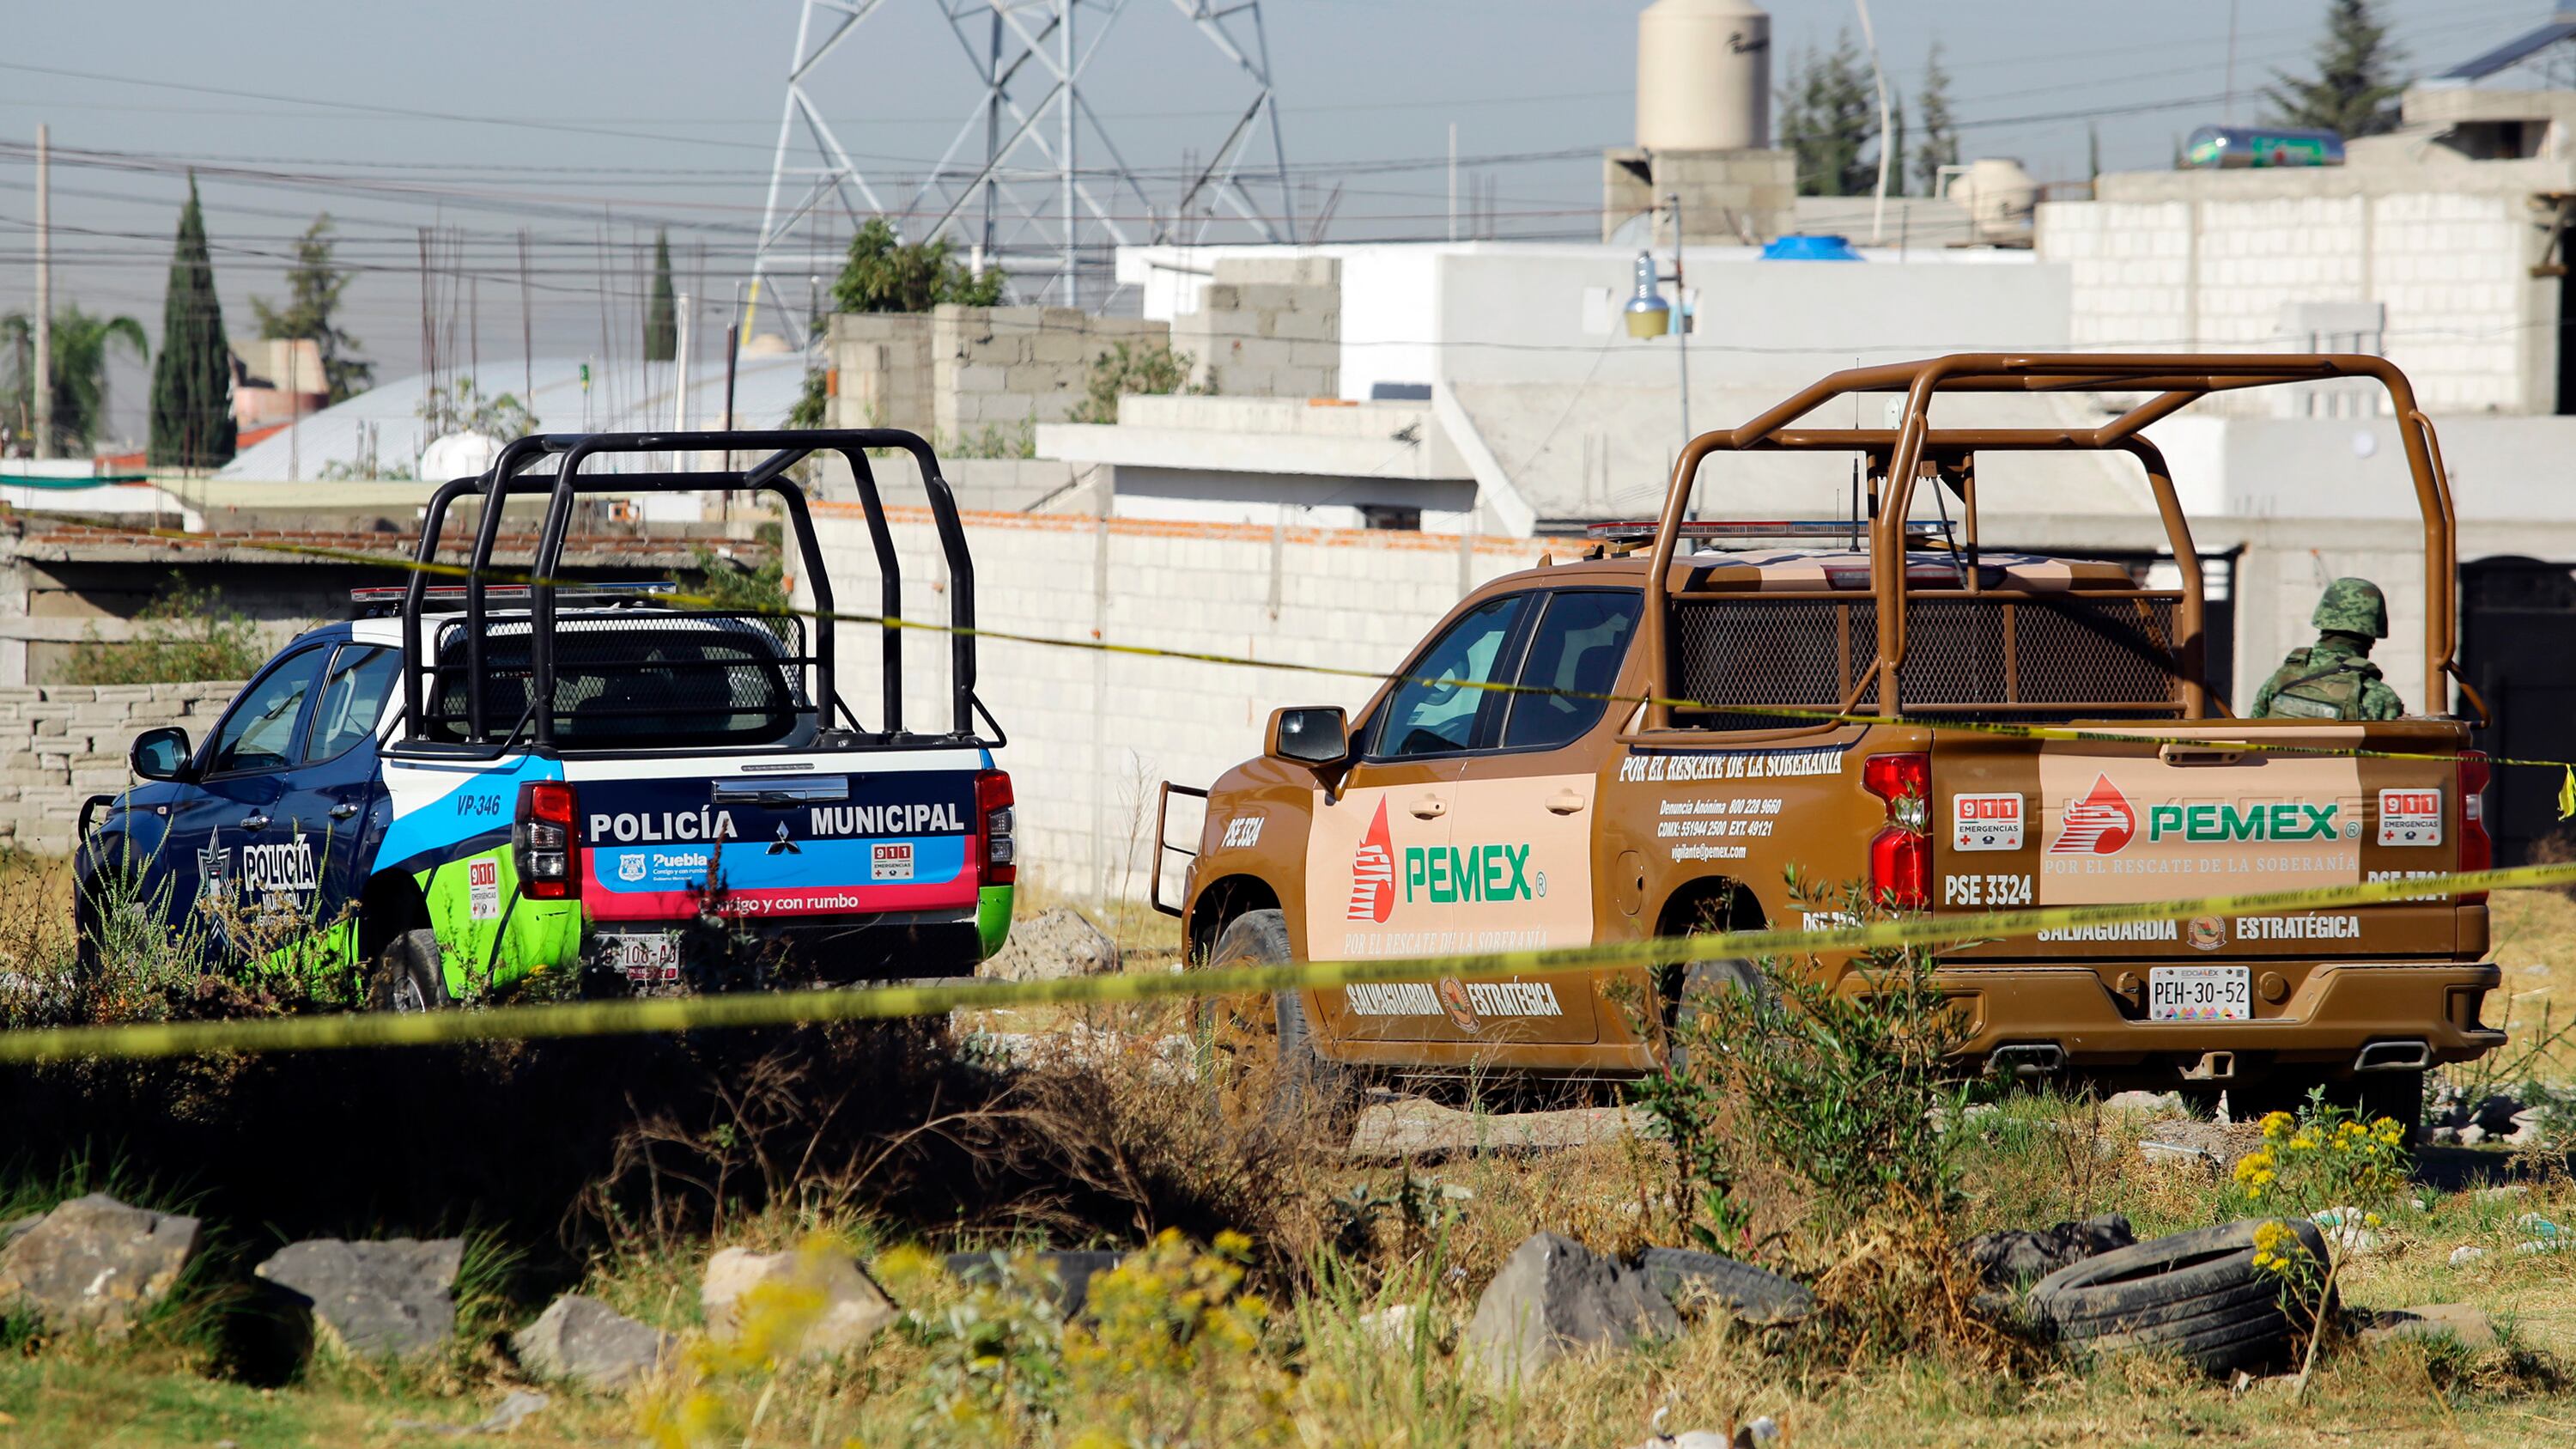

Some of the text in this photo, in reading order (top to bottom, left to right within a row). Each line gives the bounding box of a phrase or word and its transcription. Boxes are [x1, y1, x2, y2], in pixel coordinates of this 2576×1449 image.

[1619, 742, 1843, 782] POR EL RESCATE DE LA SOBERANÍA
[457, 795, 501, 816] VP-346
[1659, 798, 1782, 815] Denuncia Anónima 800 228 9660
[1962, 800, 2016, 817] 911
[2387, 796, 2434, 812] 911
[590, 802, 964, 843] POLICÍA MUNICIPAL
[1657, 820, 1774, 837] CDMX: 551944 2500 EXT. 49121
[2149, 804, 2338, 842] PEMEX
[243, 833, 317, 892] POLICÍA
[653, 852, 708, 868] Puebla
[876, 847, 908, 858] 911
[1671, 843, 1747, 863] vigilante@pemex.com
[471, 864, 495, 884] 911
[1405, 843, 1532, 903] PEMEX
[2044, 853, 2358, 874] POR EL RESCATE DE LA SOBERANÍA
[471, 892, 496, 900] EMERGENCIAS
[1945, 874, 2032, 905] PSE 3324
[762, 899, 773, 914] y
[775, 898, 804, 910] con
[805, 893, 859, 910] rumbo
[2236, 912, 2360, 940] ESTRATÉGICA
[1344, 933, 1367, 955] POR
[1368, 933, 1383, 955] EL
[1384, 933, 1438, 954] RESCATE
[1439, 931, 1456, 954] DE
[1458, 931, 1473, 953] LA
[1478, 924, 1548, 952] SOBERANÍA
[1346, 982, 1446, 1016] SALVAGUARDIA
[1465, 976, 1564, 1016] ESTRATÉGICA
[2154, 981, 2246, 1005] PEH-30-52
